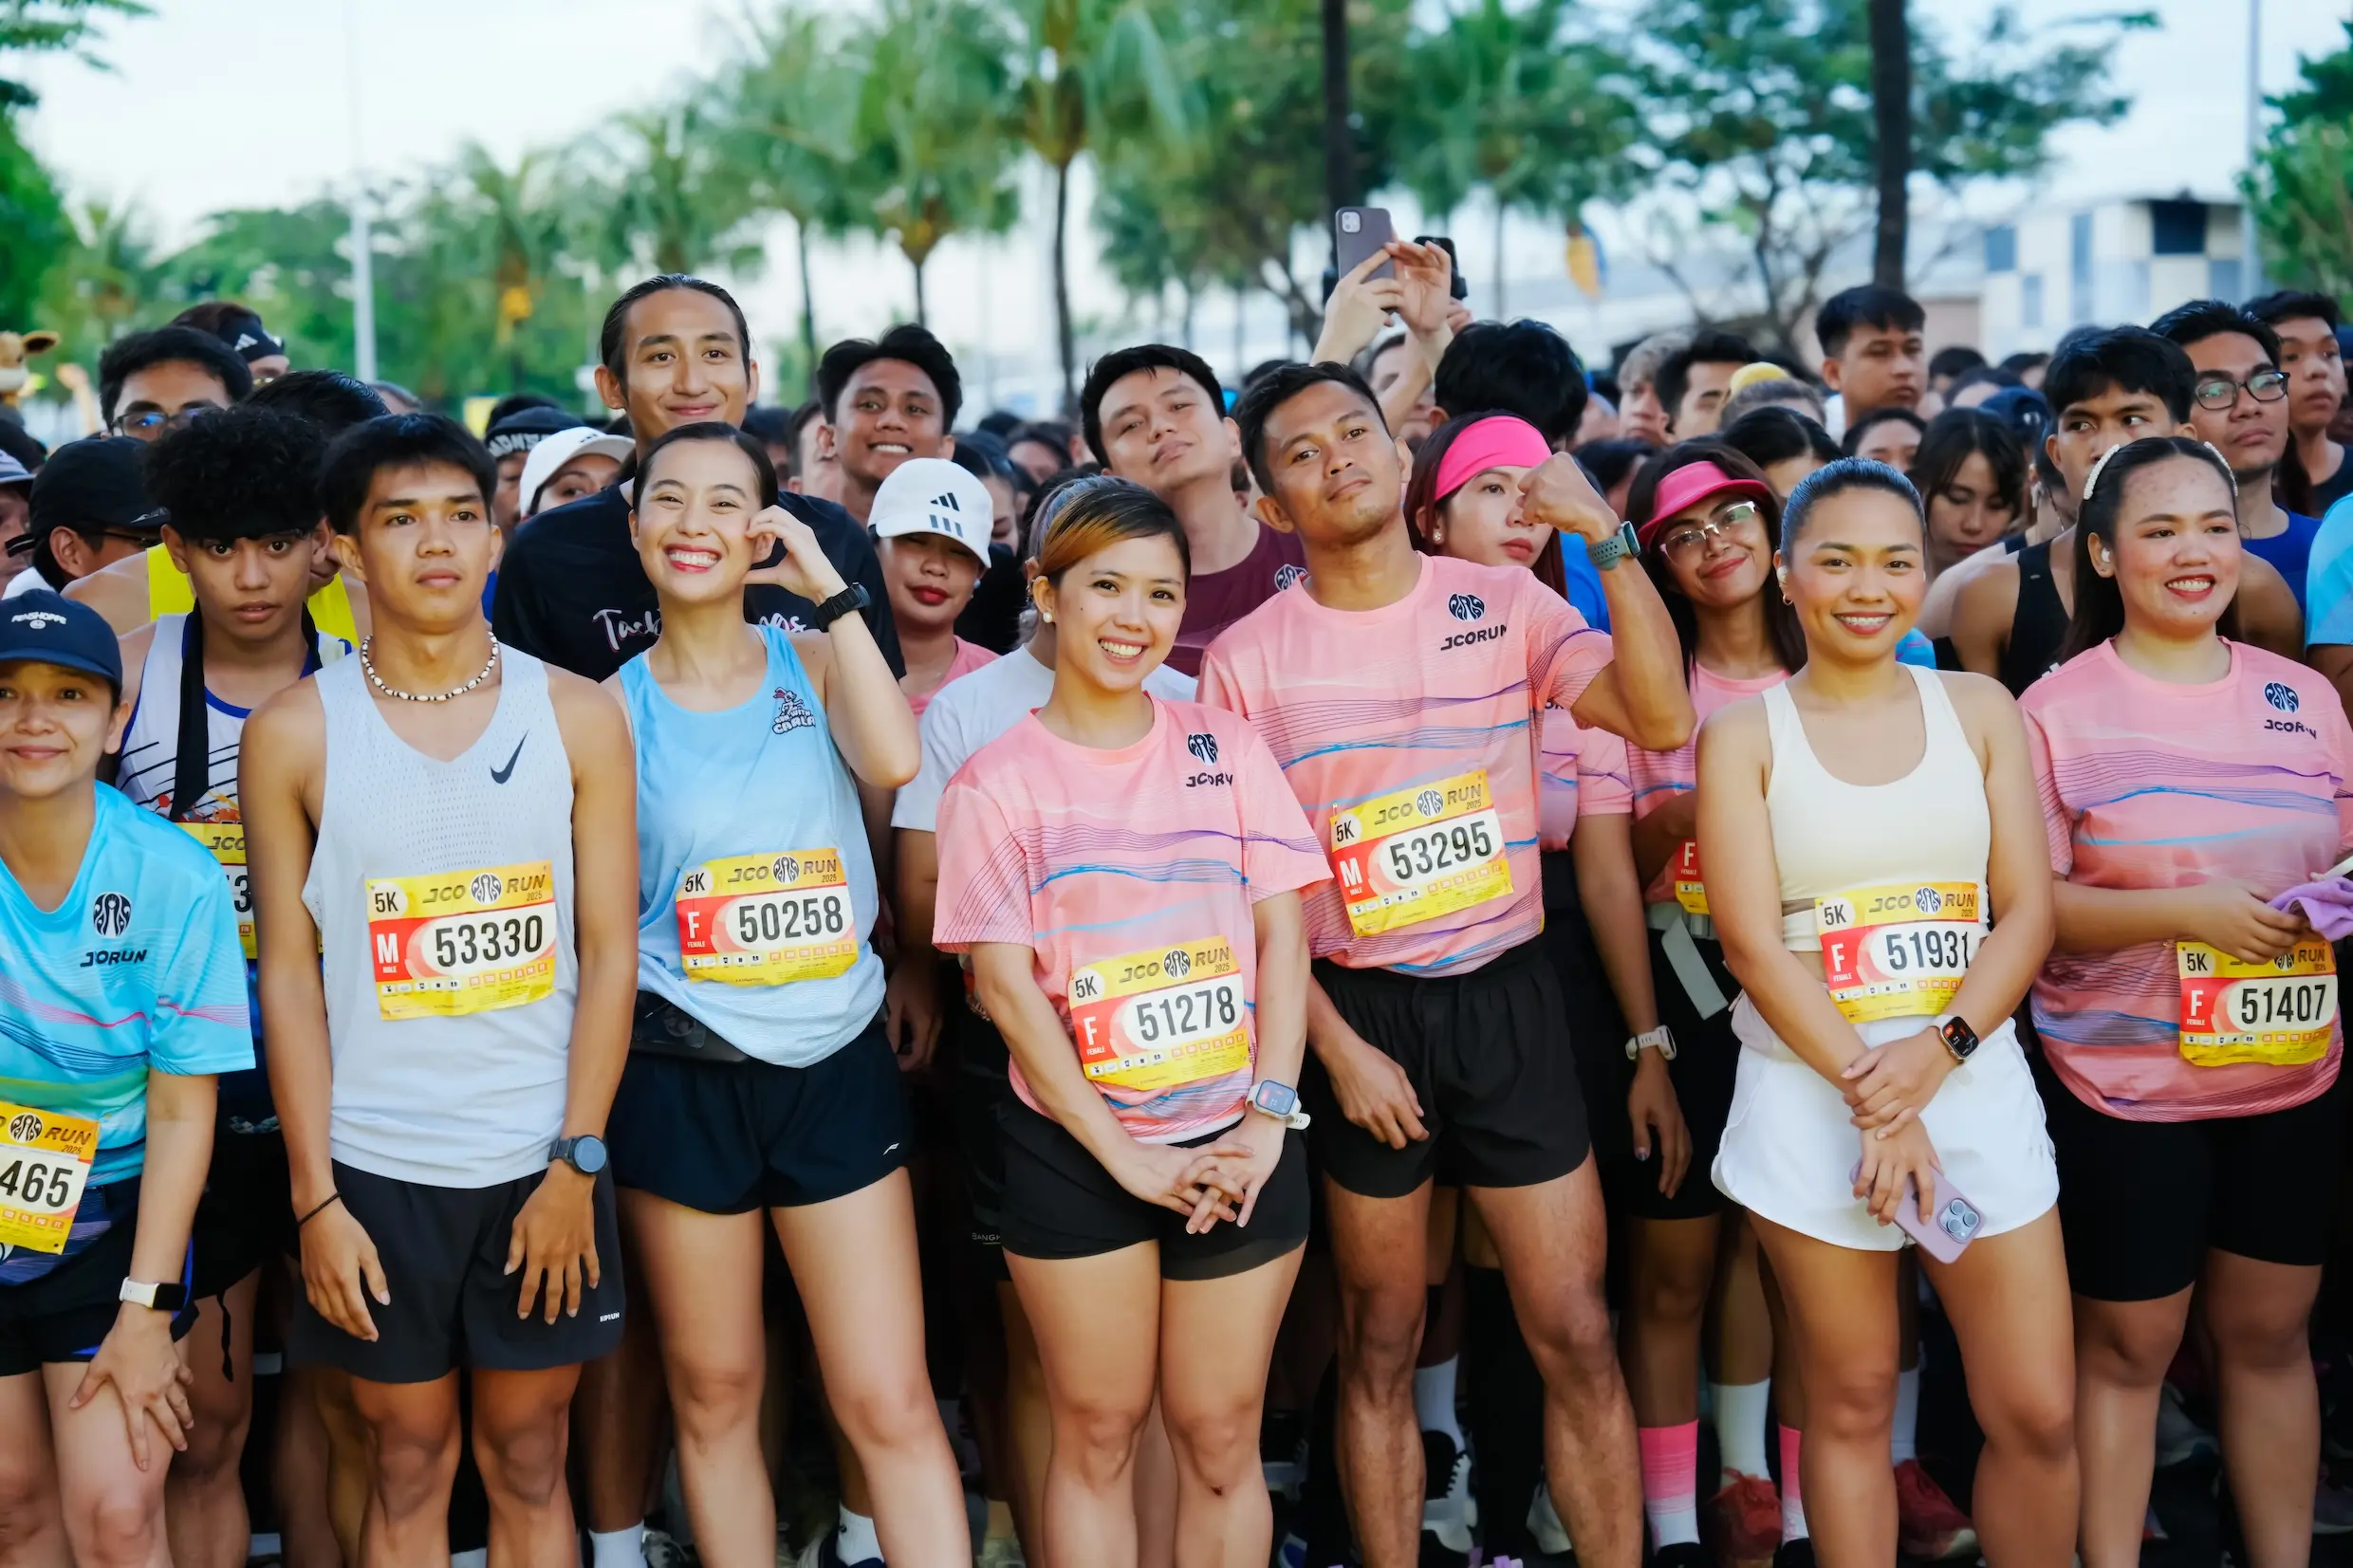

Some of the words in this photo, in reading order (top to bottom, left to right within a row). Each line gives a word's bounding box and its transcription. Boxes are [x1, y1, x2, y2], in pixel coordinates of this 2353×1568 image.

[772, 716, 816, 734] CARLA
[1374, 802, 1414, 825] JCO
[1447, 784, 1482, 805] RUN
[1466, 799, 1482, 810] 2025
[1336, 820, 1355, 842] 5K
[1389, 820, 1492, 880] 53295
[1683, 842, 1696, 867] F
[684, 872, 706, 893] 5K
[728, 866, 769, 883] JCO
[803, 859, 837, 875] RUN
[822, 874, 838, 883] 2025
[1339, 858, 1363, 887] M
[422, 885, 466, 904] JCO
[506, 875, 546, 894] RUN
[526, 892, 543, 901] 2025
[375, 892, 399, 913] 5K
[1868, 895, 1911, 913] JCO
[1945, 893, 1974, 907] RUN
[687, 912, 700, 939] F
[738, 895, 844, 943] 50258
[1824, 904, 1846, 926] 5K
[376, 932, 399, 965] M
[435, 914, 544, 968] 53330
[1885, 930, 1969, 970] 51931
[1119, 962, 1160, 984] JCO
[1195, 946, 1231, 968] RUN
[1214, 962, 1231, 973] 2025
[1830, 943, 1845, 972] F
[2186, 952, 2208, 971] 5K
[2298, 948, 2325, 963] RUN
[1075, 975, 1098, 999] 5K
[1136, 986, 1236, 1042] 51278
[2190, 989, 2204, 1017] F
[2241, 984, 2326, 1024] 51407
[1084, 1016, 1098, 1045] F
[1086, 1045, 1106, 1057] FEMALE
[45, 1127, 92, 1146] RUN
[62, 1144, 82, 1155] 2025
